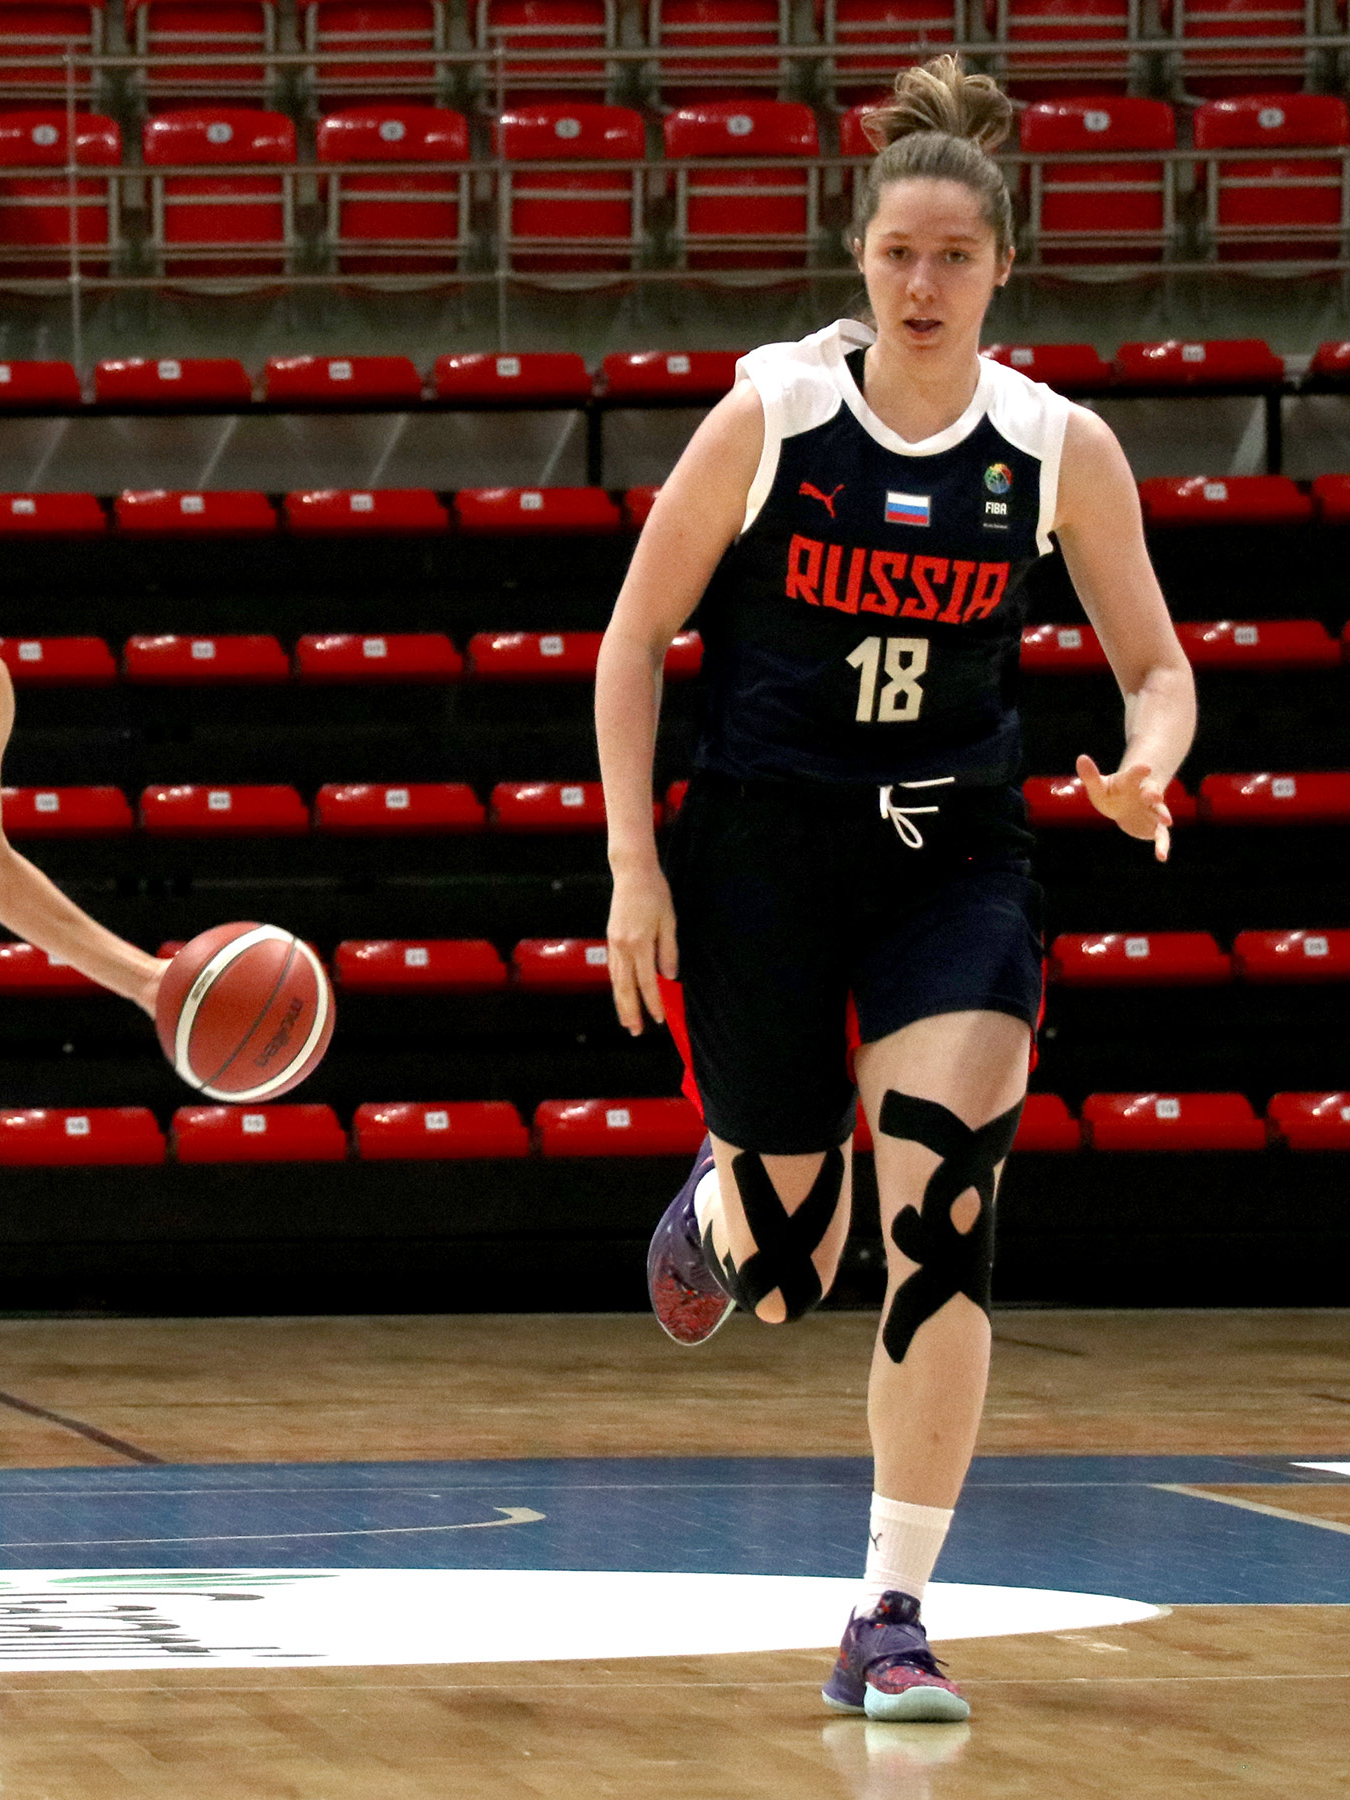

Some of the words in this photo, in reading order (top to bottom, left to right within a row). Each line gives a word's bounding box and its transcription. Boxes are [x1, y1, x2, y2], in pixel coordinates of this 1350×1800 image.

[985, 501, 1007, 515] FIBA
[785, 533, 1011, 624] RUSSIA
[845, 636, 929, 722] 18
